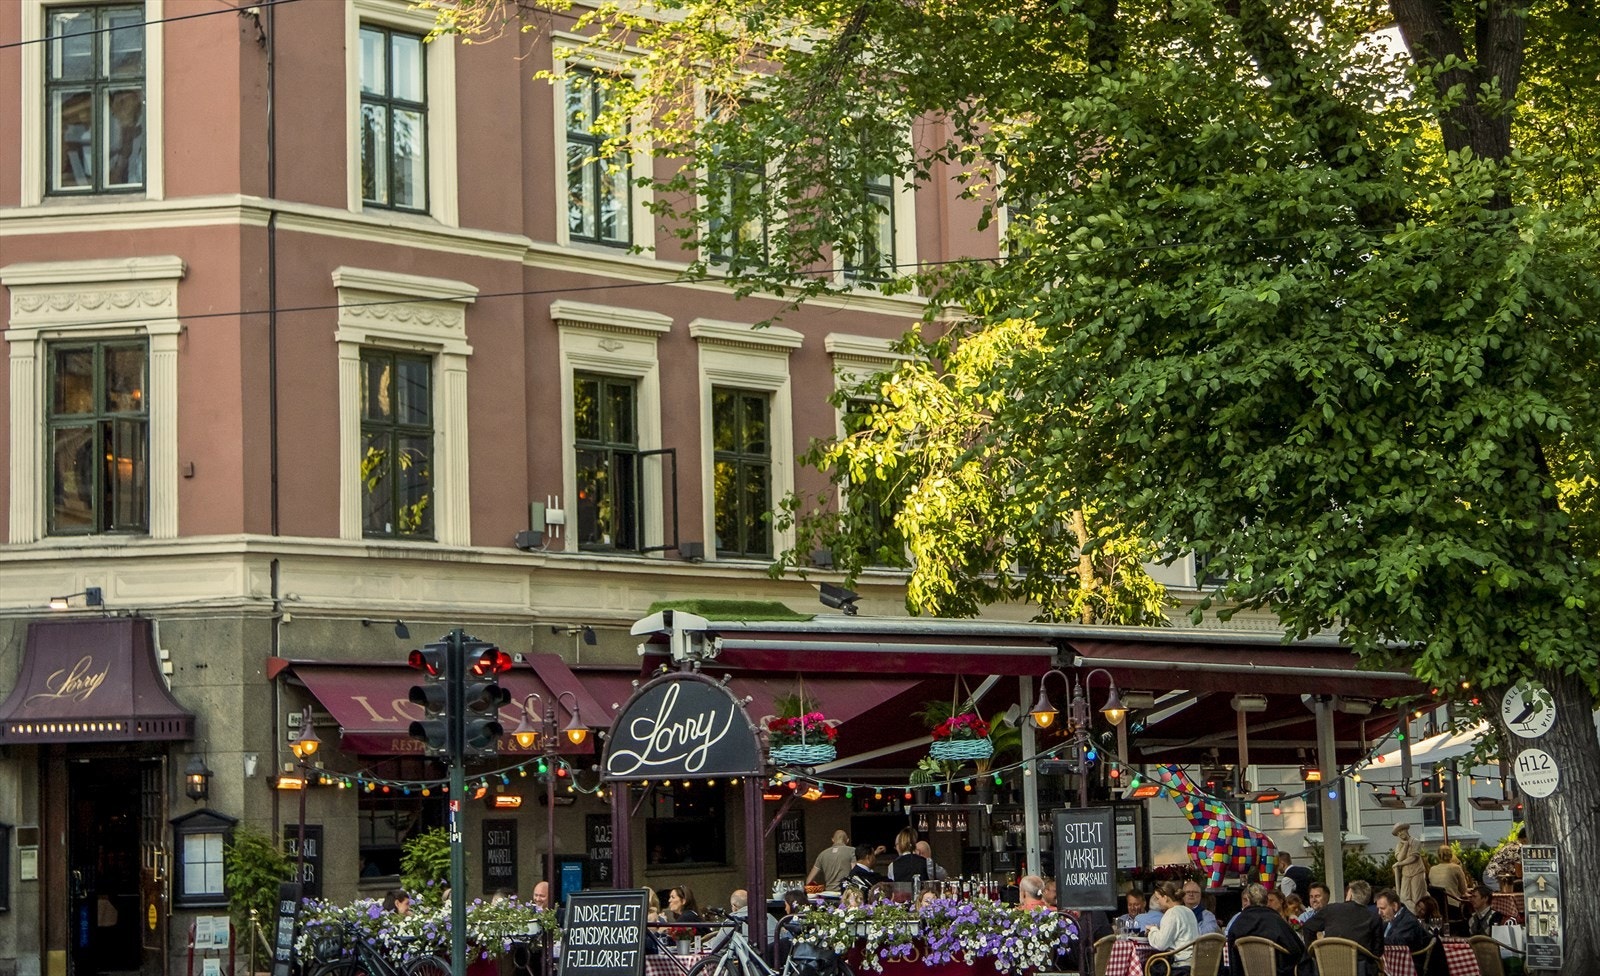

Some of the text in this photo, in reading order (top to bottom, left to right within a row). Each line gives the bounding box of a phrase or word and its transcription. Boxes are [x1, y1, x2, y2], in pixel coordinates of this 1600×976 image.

[24, 655, 110, 708] Lorry
[607, 682, 735, 776] Lorry
[1518, 753, 1551, 772] H12
[488, 830, 511, 846] STEKT
[1065, 821, 1103, 845] STEKT
[487, 848, 513, 864] MAKRELL
[1064, 847, 1107, 870] MAKRELL
[1528, 849, 1551, 858] EMBLA
[1065, 871, 1109, 887] AGURKSALAT
[573, 904, 641, 922] INDREFILET
[568, 926, 639, 946] REINSDYRKAKER
[566, 949, 638, 968] FJELLØRRET
